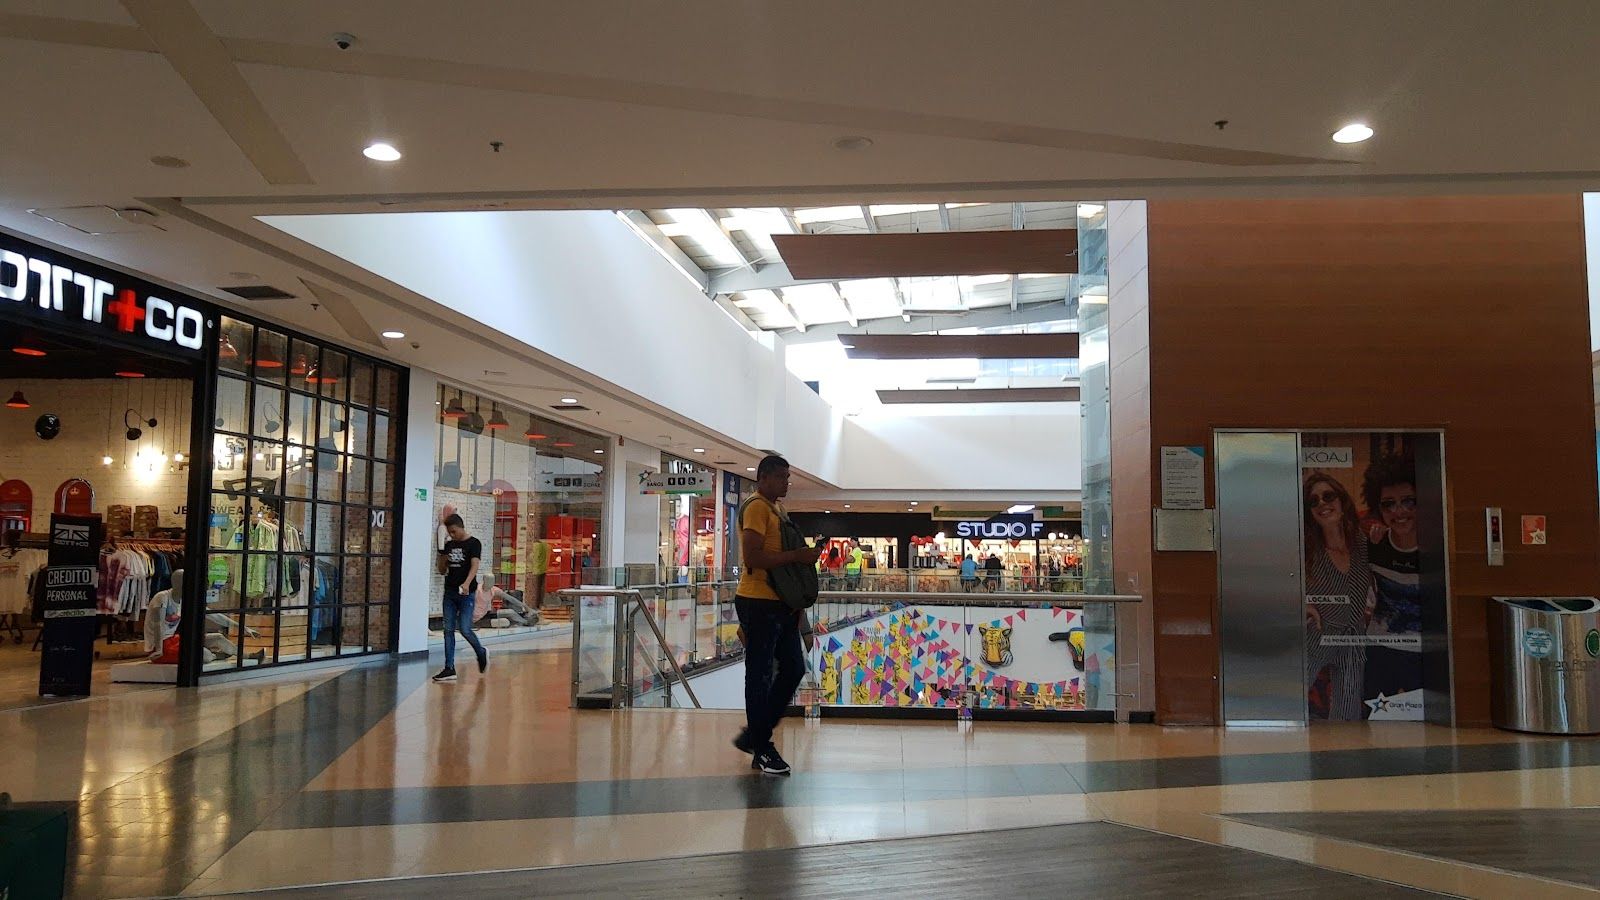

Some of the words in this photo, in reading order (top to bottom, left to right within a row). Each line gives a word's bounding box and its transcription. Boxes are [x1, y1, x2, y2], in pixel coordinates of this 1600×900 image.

[1304, 452, 1349, 464] KOAJ
[956, 521, 1027, 538] STUDIO
[1030, 522, 1044, 538] F
[46, 590, 89, 602] PERSONAL
